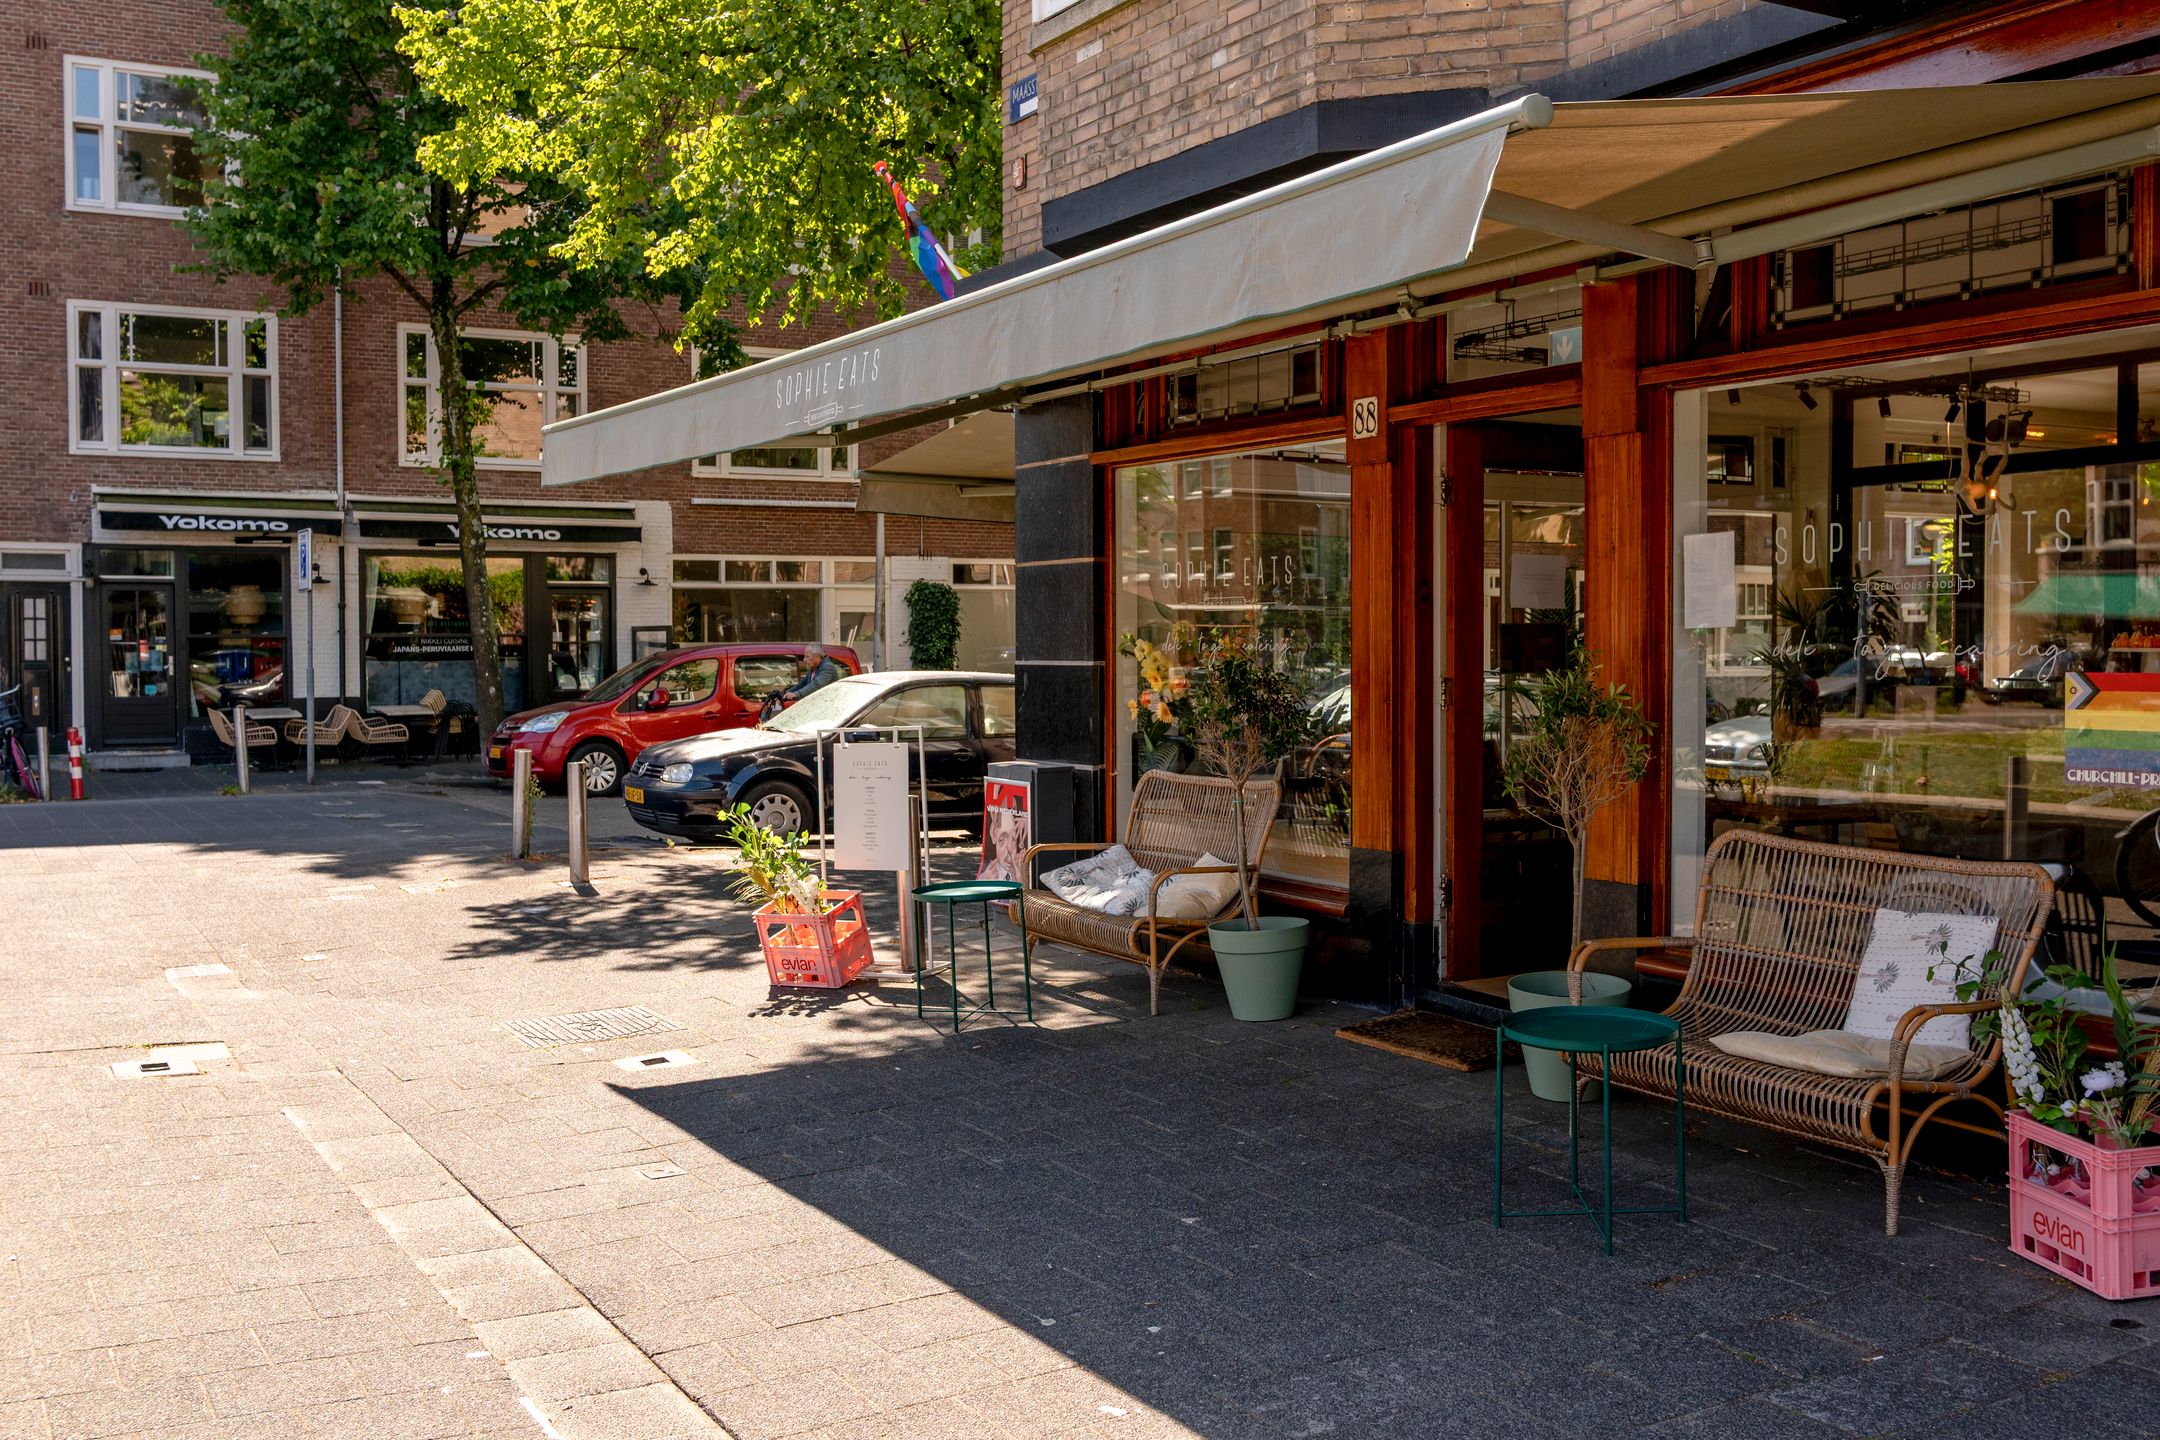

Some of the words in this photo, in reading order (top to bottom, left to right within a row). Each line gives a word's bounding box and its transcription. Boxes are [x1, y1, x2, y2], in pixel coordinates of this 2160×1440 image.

[776, 362, 831, 409] SOPHIE
[838, 348, 880, 390] EATS
[1355, 401, 1376, 435] 88
[159, 515, 289, 531] Yokomo
[447, 524, 561, 541] Ykomo
[1958, 508, 2072, 558] EATS
[1162, 558, 1230, 589] SOPHIE
[1244, 555, 1293, 586] EATS
[1874, 580, 1923, 592] DELICIOUS
[1926, 579, 1954, 590] FOOD
[392, 645, 470, 653] JAPANS-PERUVIAANSE
[1161, 631, 1183, 654] deli
[1241, 631, 1291, 663] catering
[1772, 627, 1817, 662] deli
[1954, 625, 2067, 683] catering
[2067, 769, 2160, 786] CHURCHILL-PR
[781, 957, 817, 971] evian
[2033, 1211, 2085, 1255] evian
